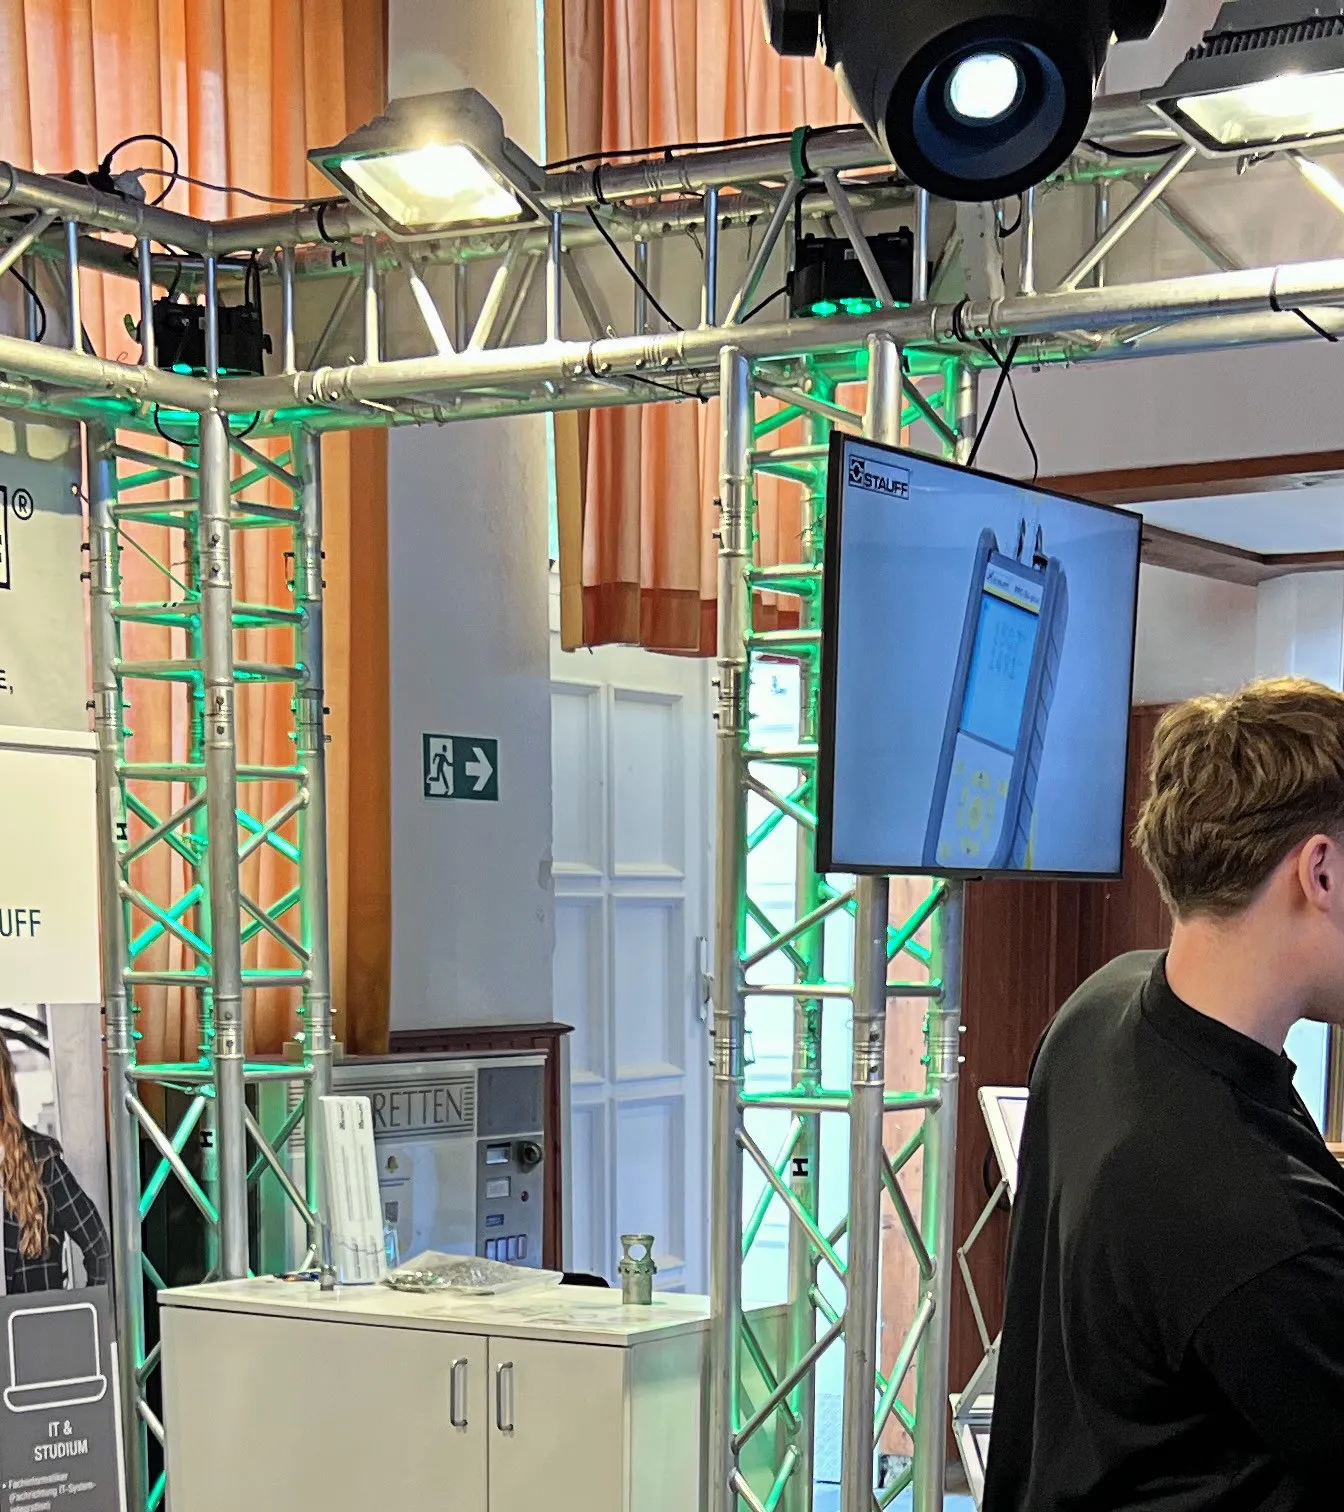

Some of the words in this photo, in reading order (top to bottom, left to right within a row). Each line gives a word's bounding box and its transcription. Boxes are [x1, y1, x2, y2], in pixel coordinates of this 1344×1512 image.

[864, 473, 909, 495] STAUFF
[48, 1421, 60, 1438] IT
[63, 1420, 73, 1436] &
[34, 1438, 89, 1462] STUDIUM
